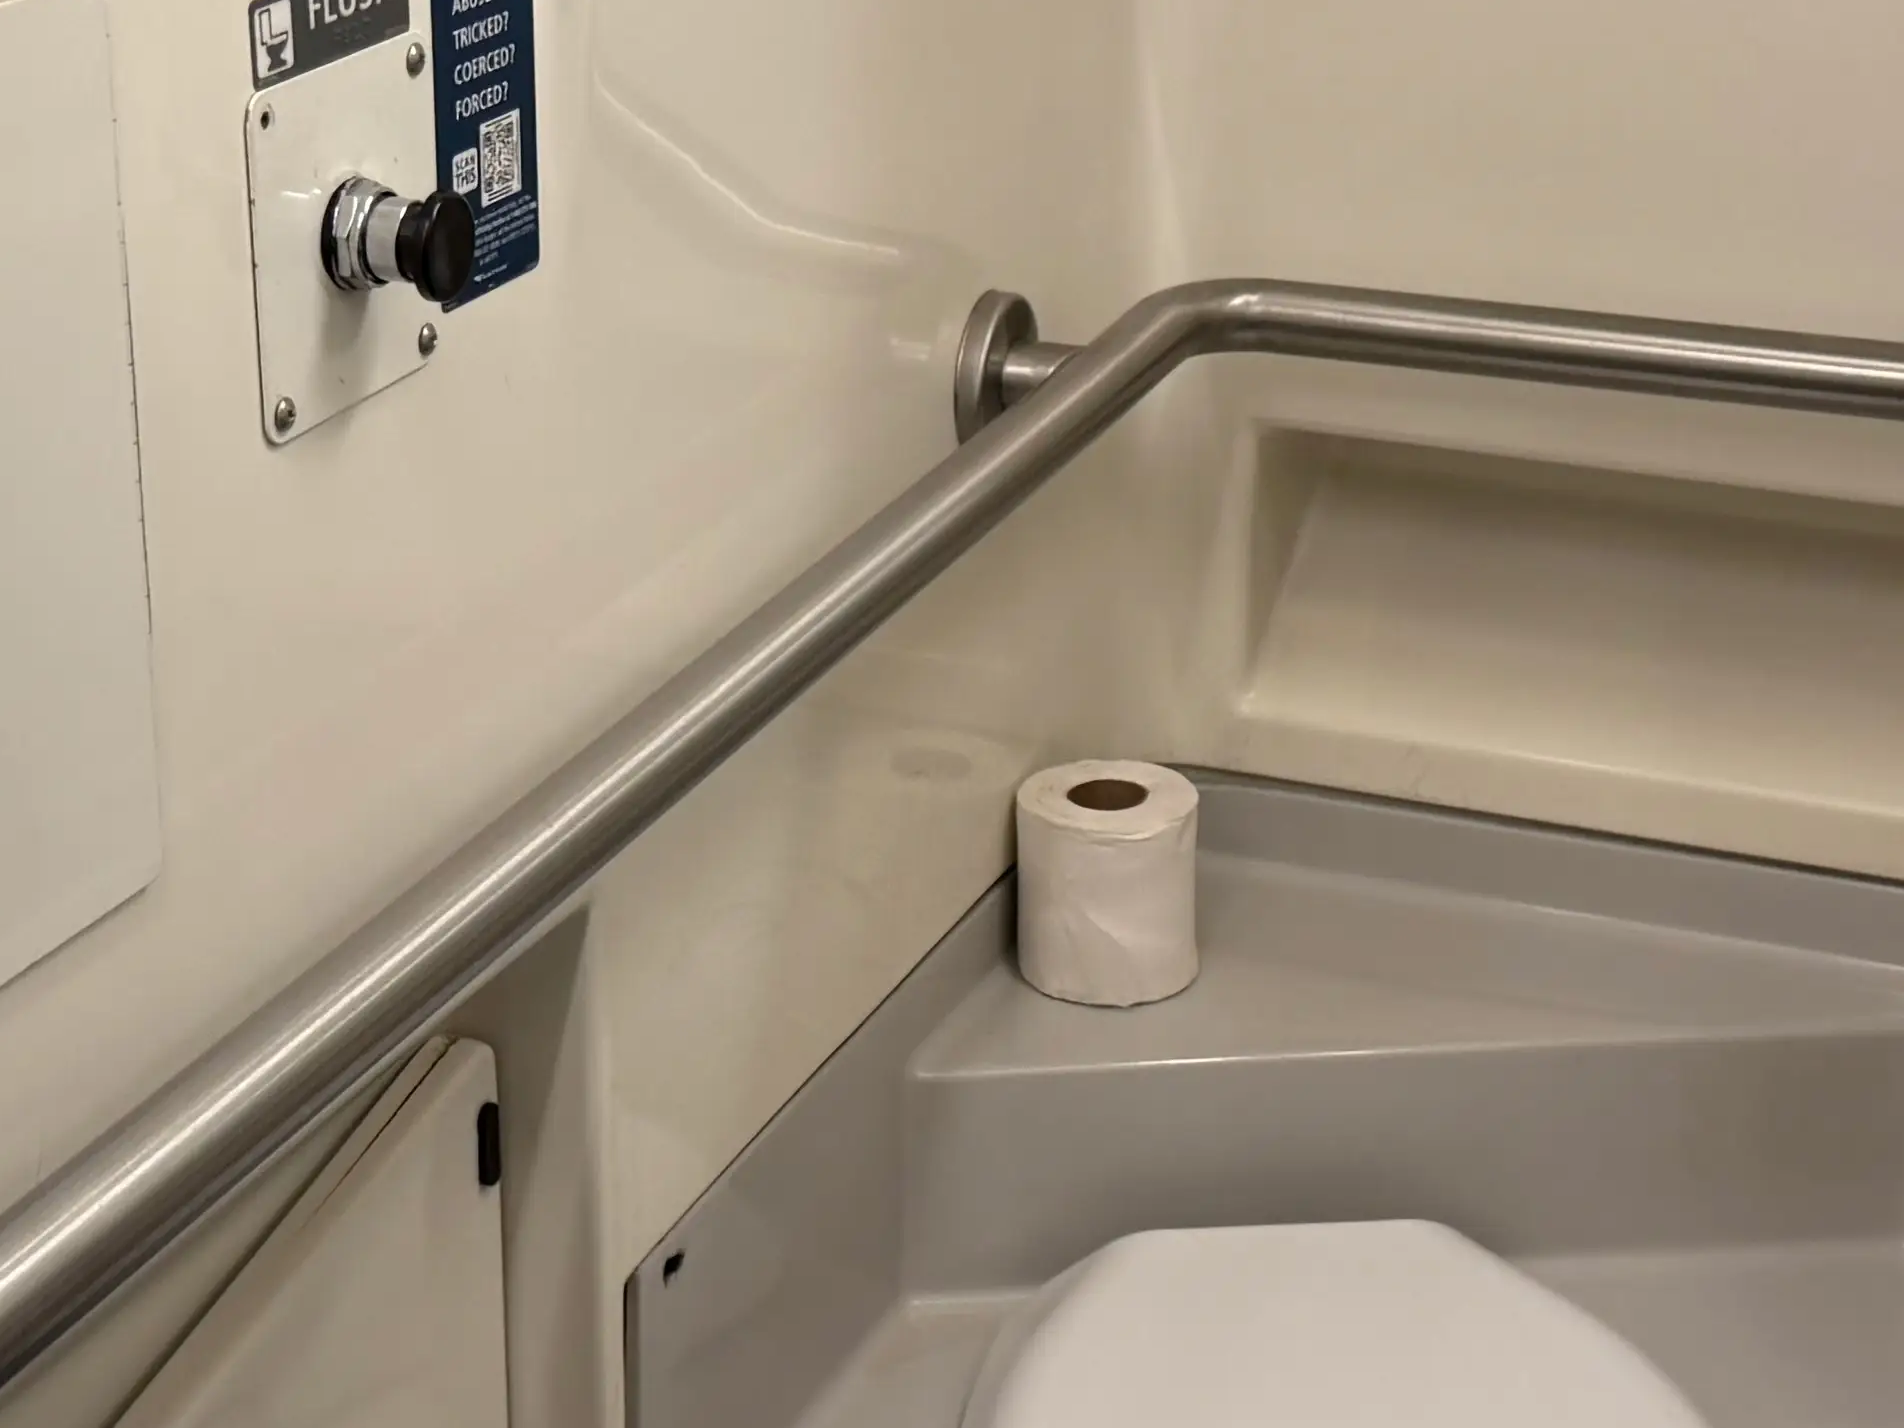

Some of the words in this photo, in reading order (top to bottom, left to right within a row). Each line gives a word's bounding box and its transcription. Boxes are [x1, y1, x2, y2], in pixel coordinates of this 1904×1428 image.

[452, 10, 509, 50] TRICKED?
[454, 43, 515, 85] COERCED?
[455, 80, 508, 121] FORCED?
